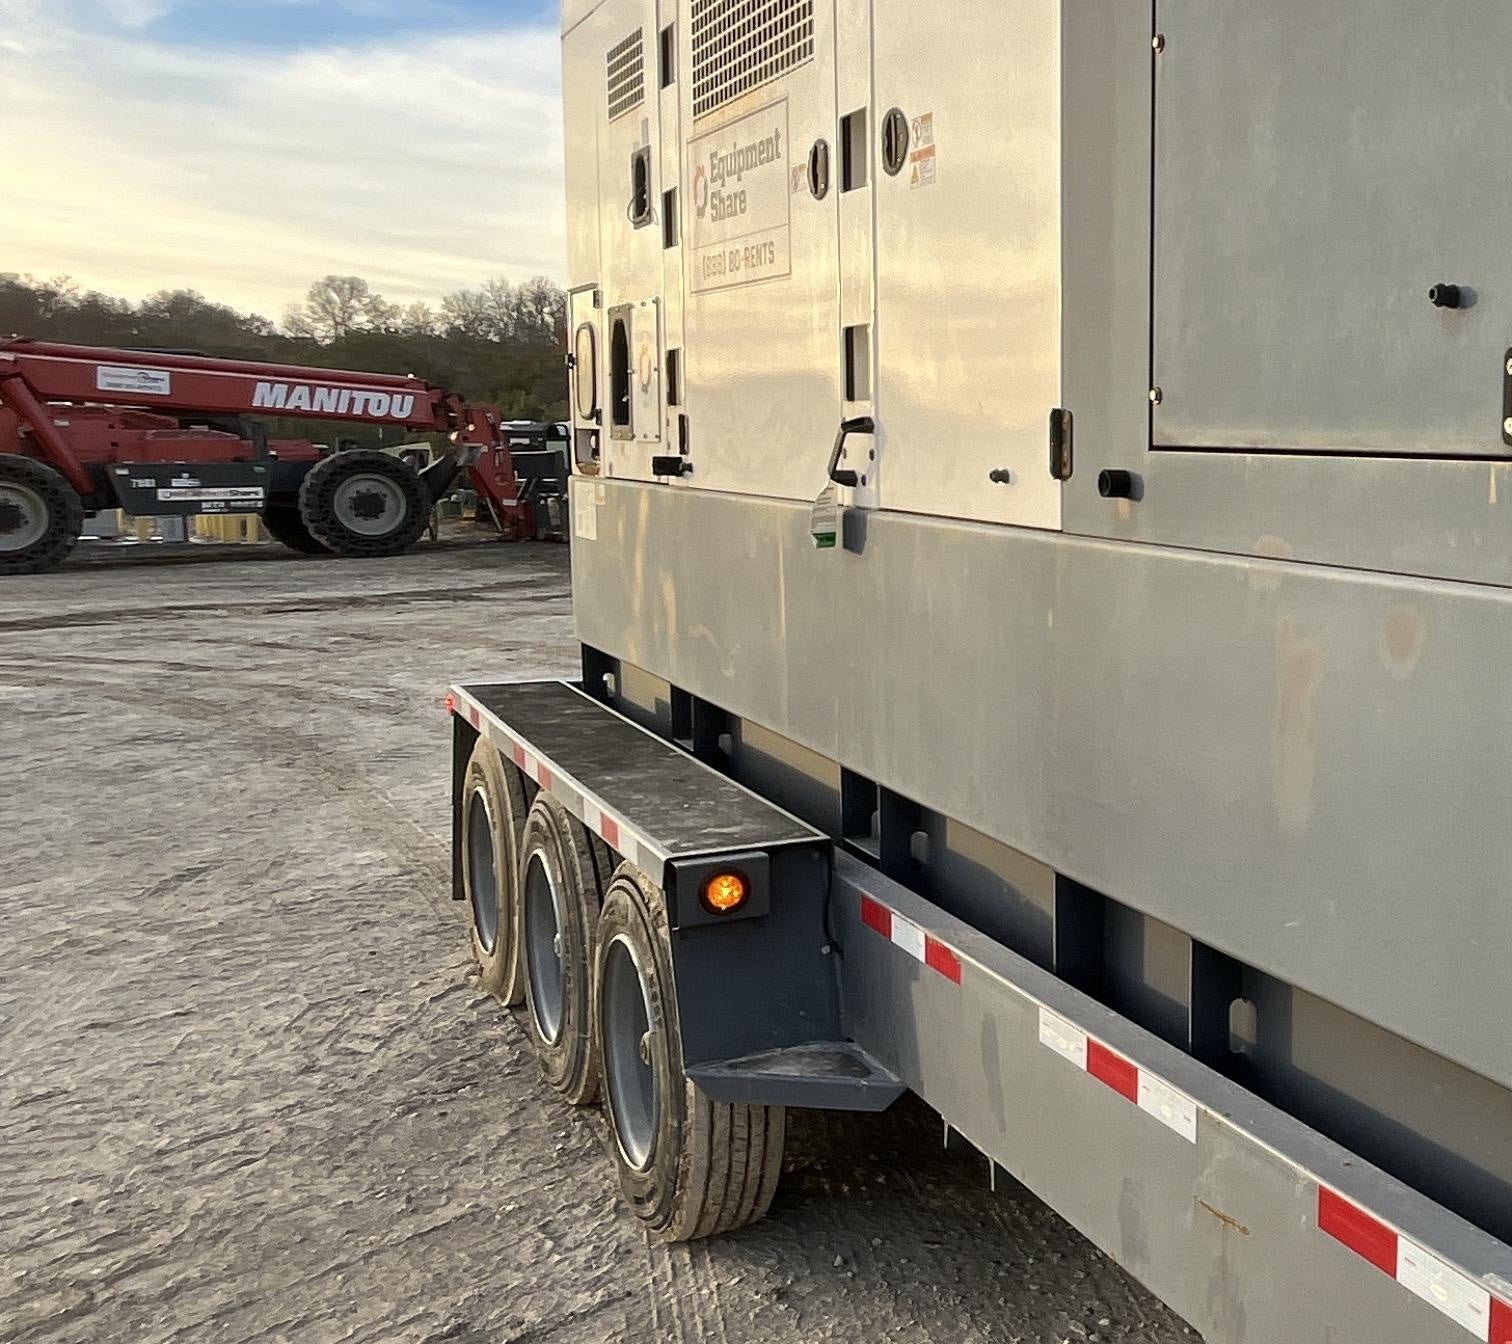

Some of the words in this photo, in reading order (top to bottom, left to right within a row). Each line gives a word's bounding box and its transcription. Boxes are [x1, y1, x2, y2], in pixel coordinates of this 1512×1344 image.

[710, 127, 781, 188] Equipment
[710, 189, 747, 222] Share
[251, 381, 415, 420] MANITOU
